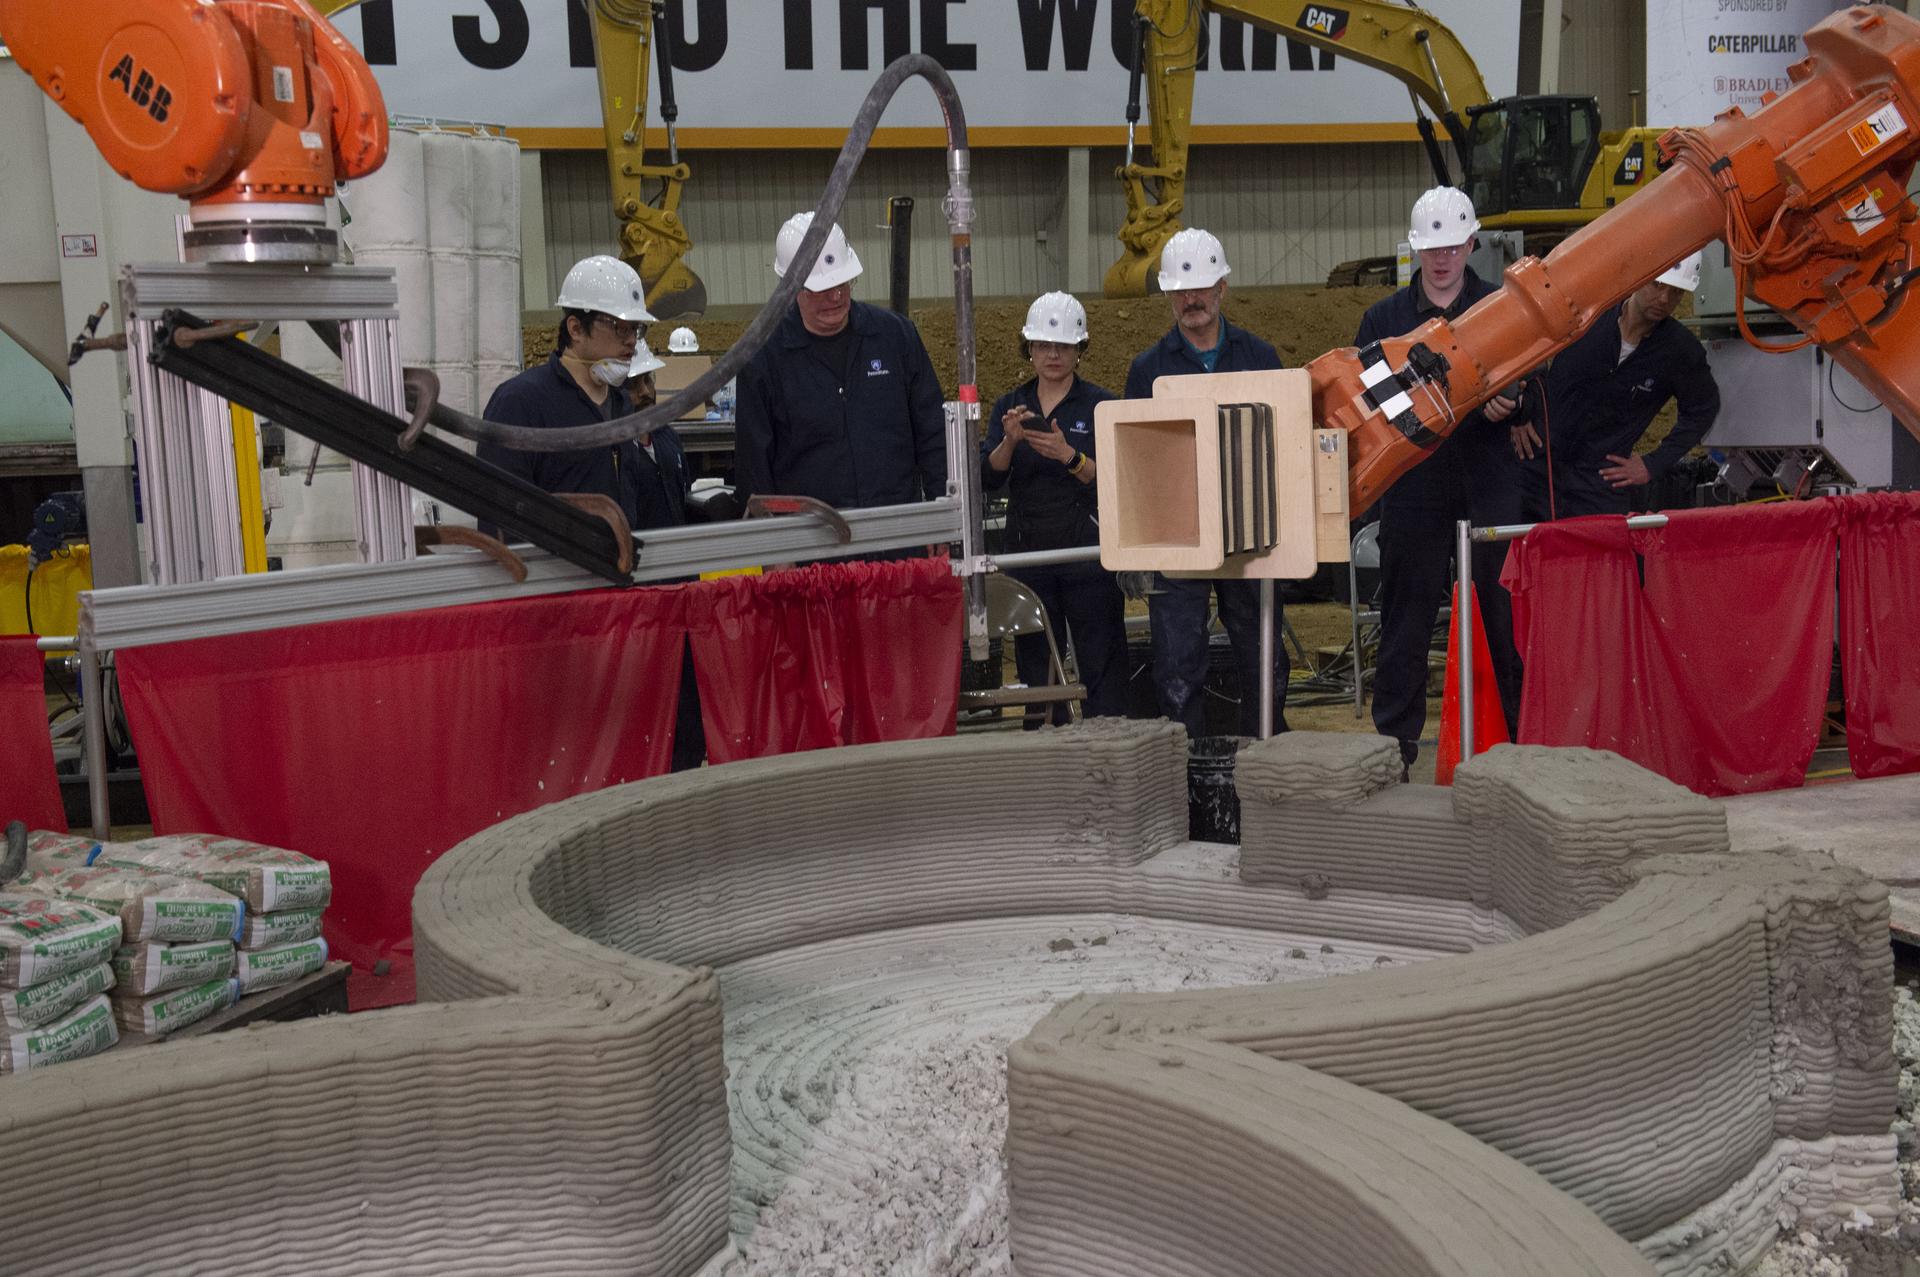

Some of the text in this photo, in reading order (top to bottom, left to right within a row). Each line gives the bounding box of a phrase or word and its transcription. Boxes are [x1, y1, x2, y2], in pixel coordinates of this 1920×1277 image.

[1718, 0, 1788, 12] SPONSORED BY
[1306, 7, 1336, 35] CAT
[1708, 34, 1797, 53] CATERPILLAR
[108, 53, 173, 123] ABB
[1729, 78, 1791, 92] BRADLEY
[1624, 157, 1642, 170] CAT
